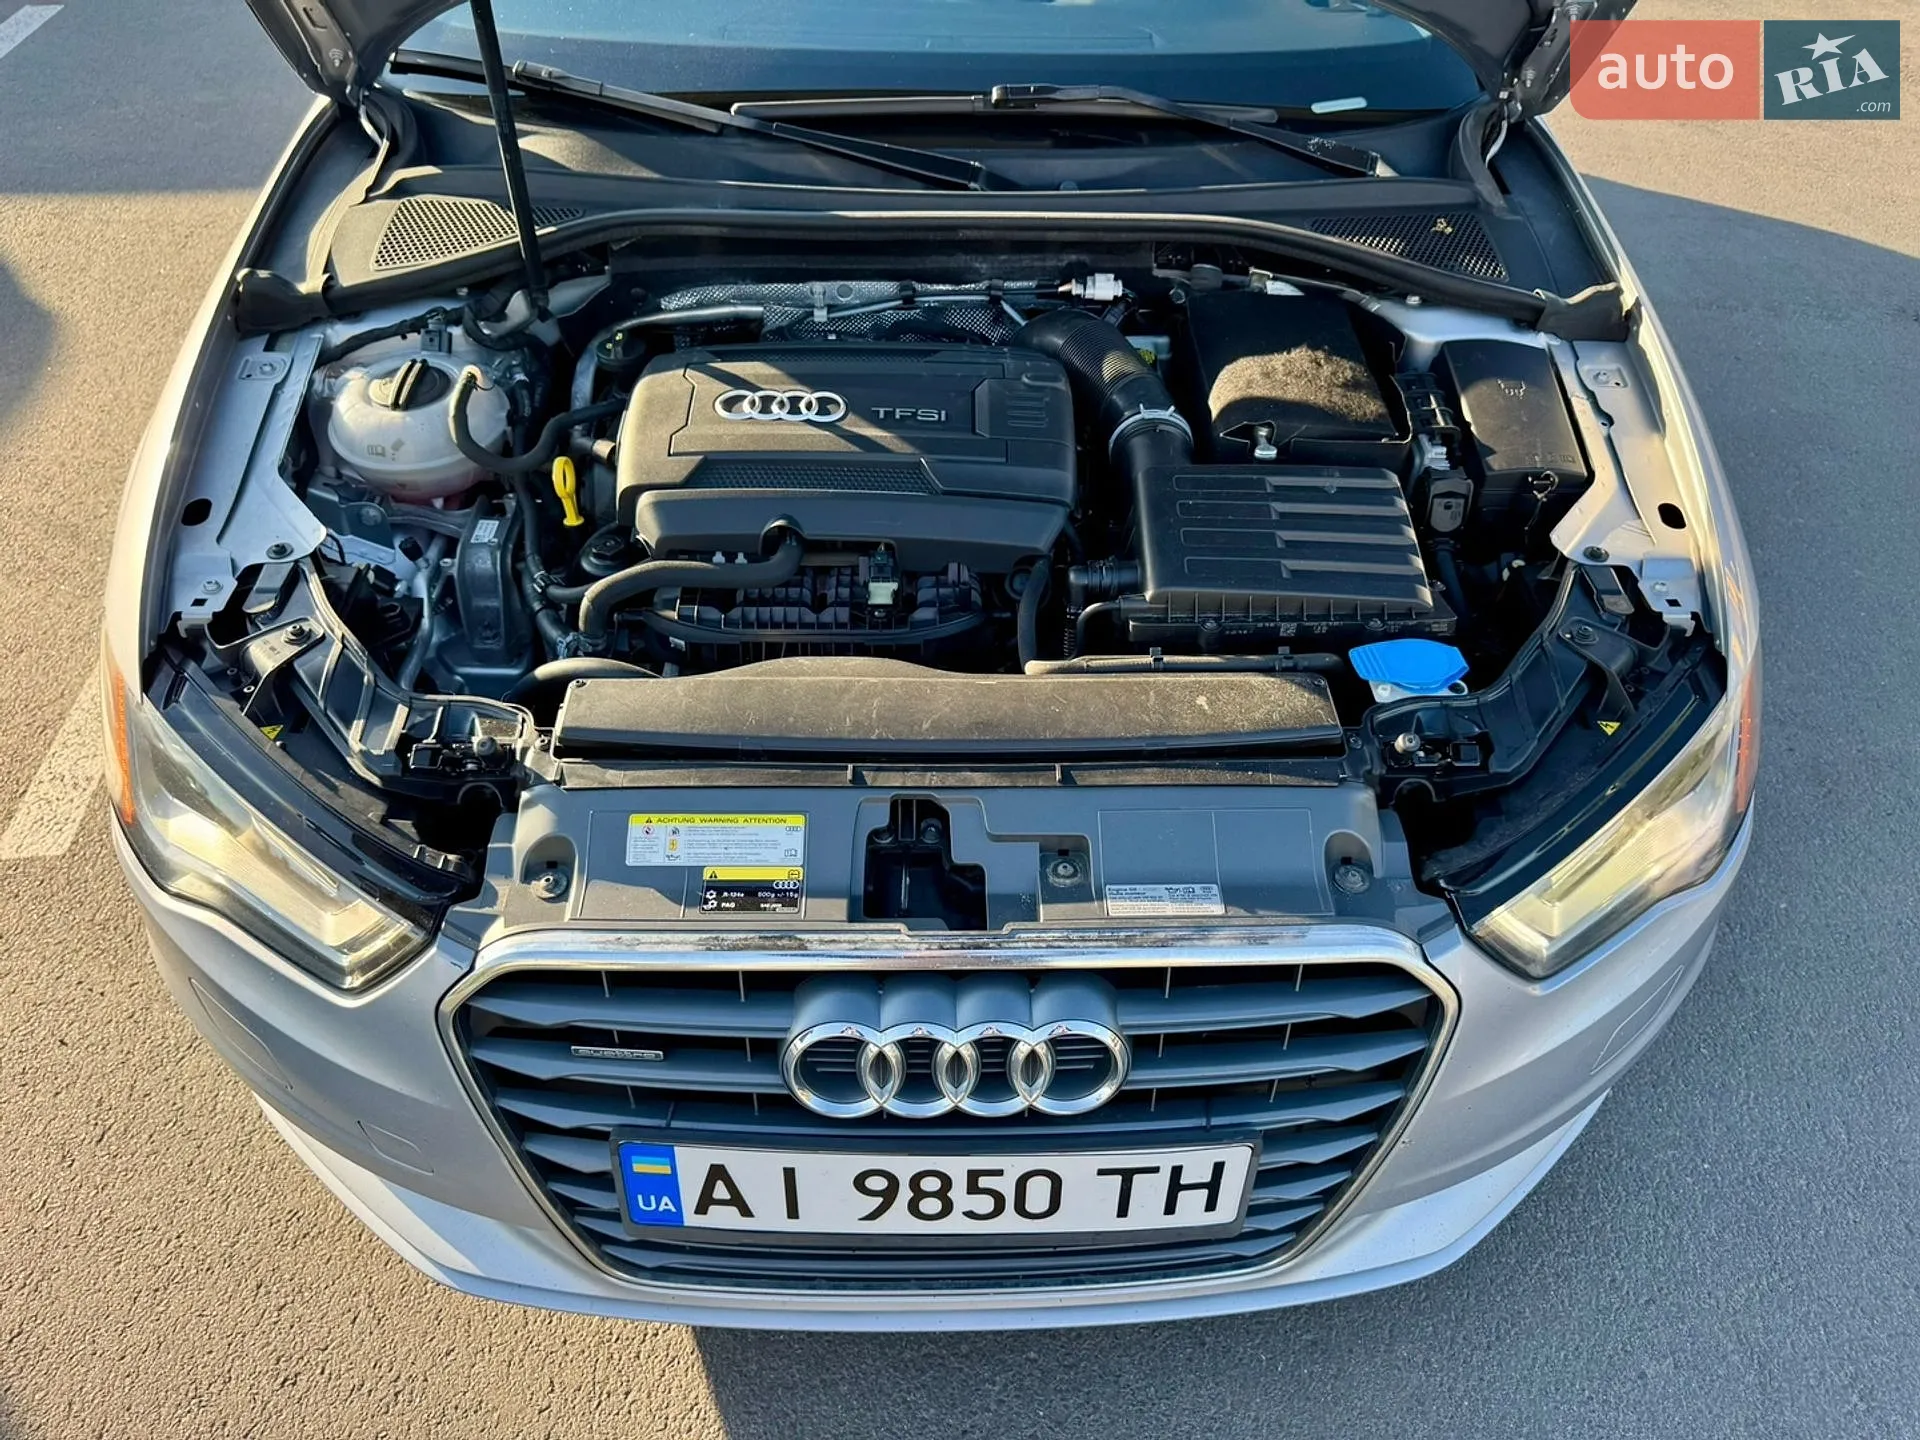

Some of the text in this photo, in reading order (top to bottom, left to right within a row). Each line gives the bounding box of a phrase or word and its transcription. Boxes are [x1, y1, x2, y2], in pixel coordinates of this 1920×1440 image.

[871, 407, 946, 421] TFSI
[693, 1160, 1227, 1222] AI 9850 TH
[637, 1193, 676, 1213] UA
